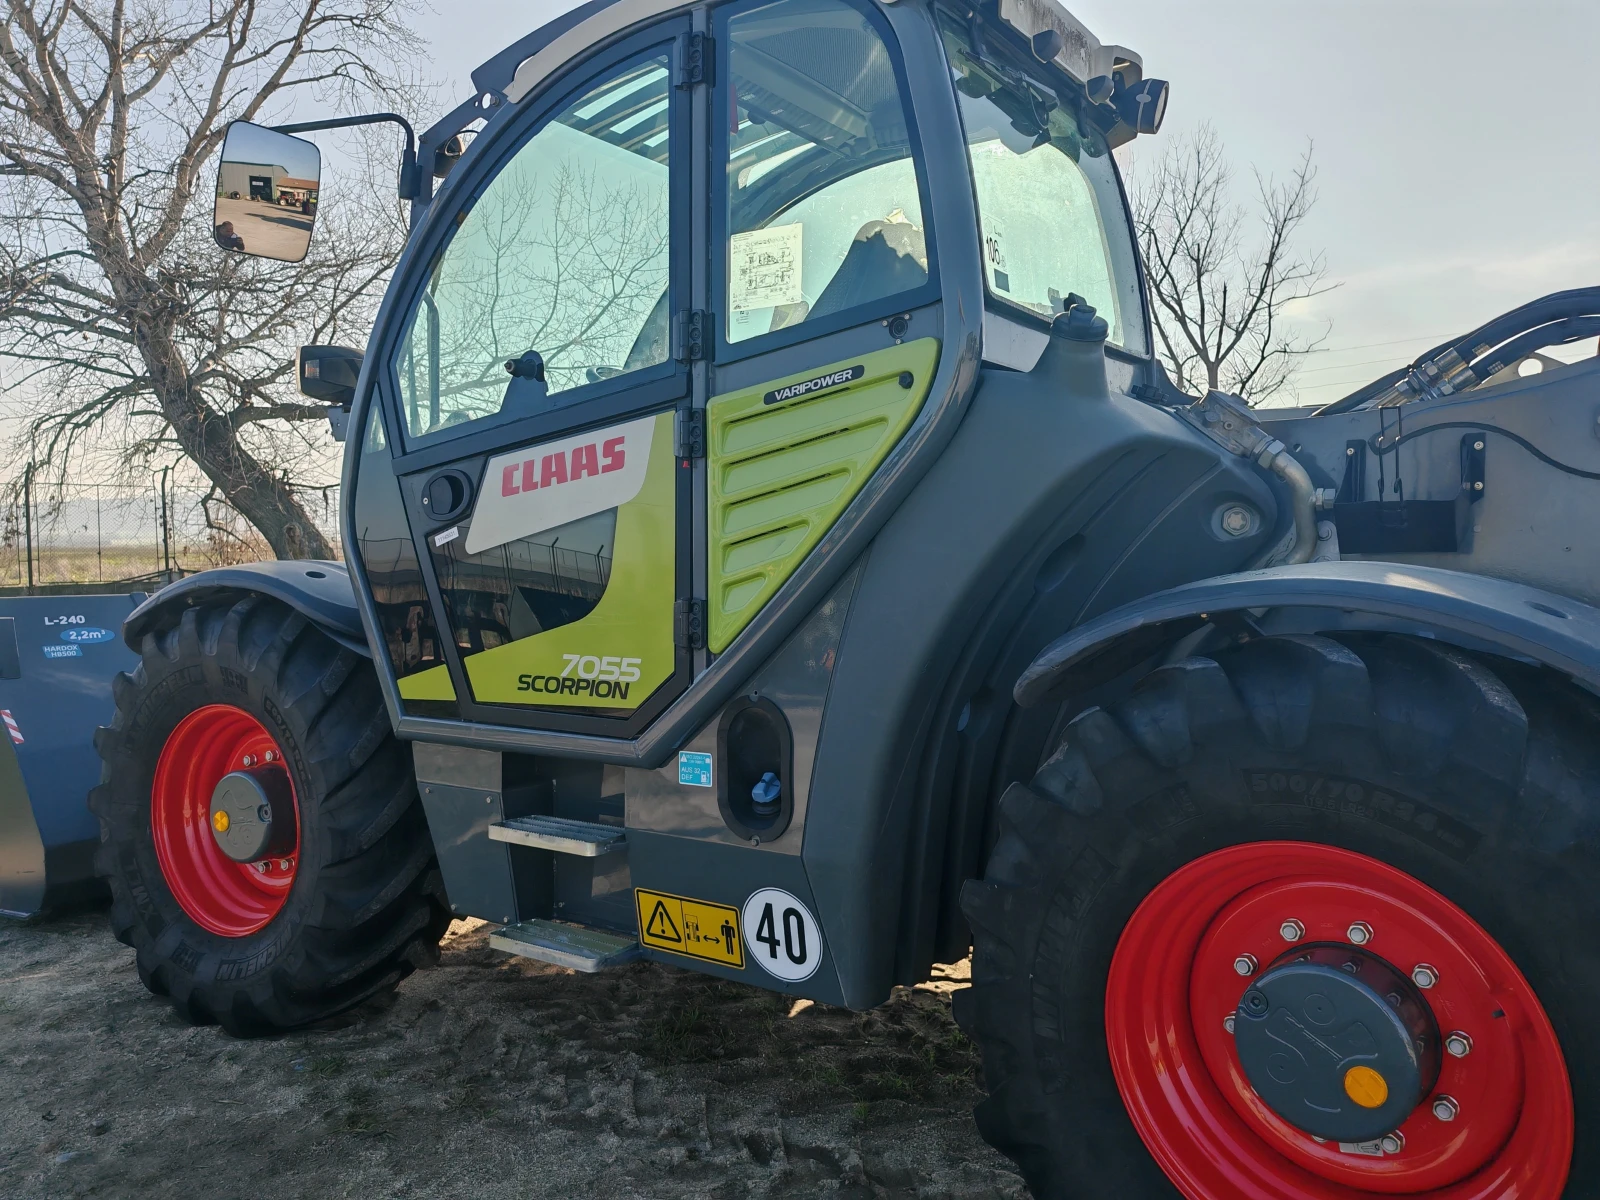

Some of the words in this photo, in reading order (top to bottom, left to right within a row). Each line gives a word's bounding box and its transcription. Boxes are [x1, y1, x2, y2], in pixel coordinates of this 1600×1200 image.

[775, 369, 853, 401] VARIPOWER
[502, 436, 626, 497] CLAAS
[44, 615, 86, 626] L-240
[44, 645, 79, 653] HARDOX
[51, 650, 77, 658] HB500
[560, 653, 642, 682] 7055
[517, 674, 630, 700] SCORPION
[1251, 772, 1365, 803] 500/70
[755, 902, 808, 965] 40
